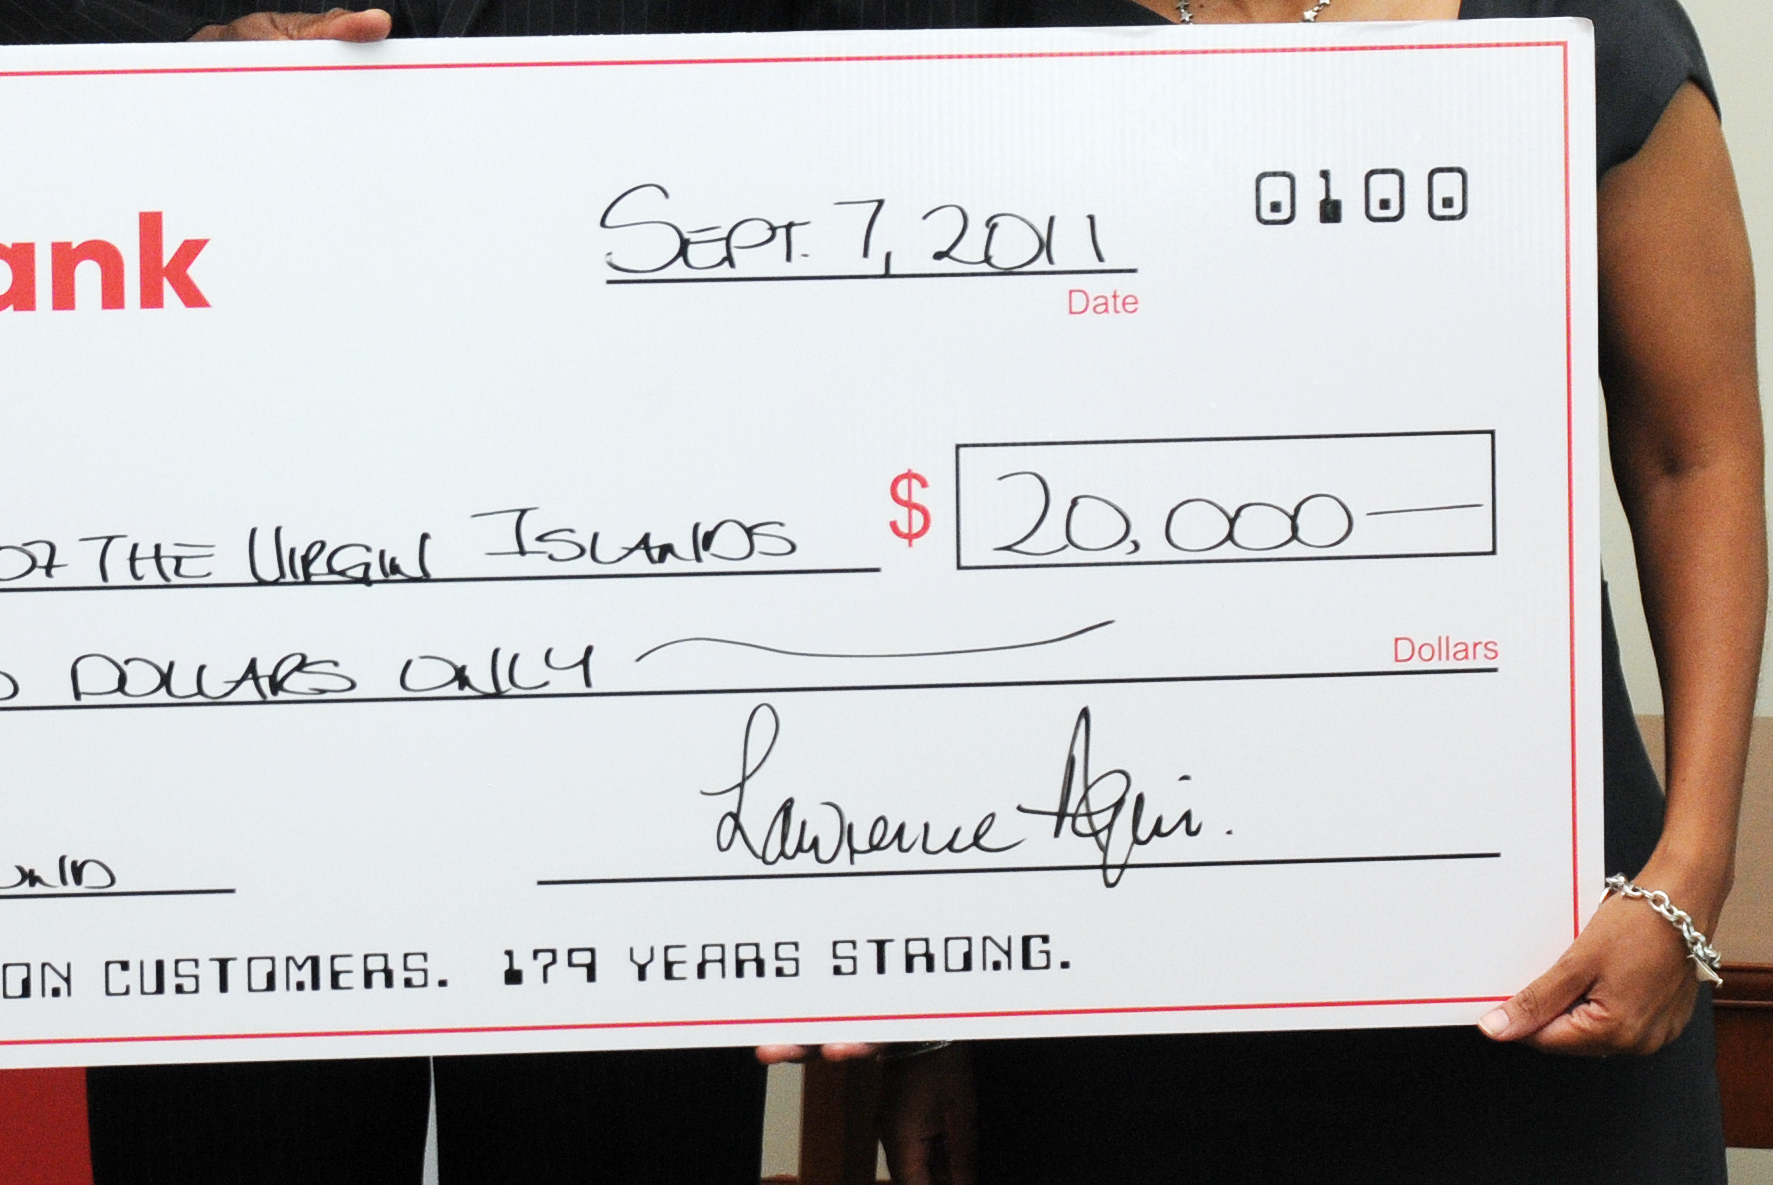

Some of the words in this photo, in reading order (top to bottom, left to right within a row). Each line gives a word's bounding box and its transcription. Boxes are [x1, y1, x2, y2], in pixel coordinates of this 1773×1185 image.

[1256, 167, 1467, 225] 0100
[836, 199, 891, 273] 7,
[923, 206, 1104, 269] 2011
[1068, 289, 1139, 315] Date
[889, 468, 932, 548] $
[80, 534, 217, 583] THE
[248, 526, 432, 585] VIRGIN
[472, 506, 797, 564] ISLANDS
[71, 653, 357, 701] DOLLARS
[399, 645, 593, 695] ONLY
[1393, 636, 1499, 663] Dollars
[104, 951, 449, 998] CUSTOMERS.
[503, 947, 598, 986] 179
[629, 941, 801, 982] YEARS
[832, 934, 1071, 976] STRONG.
